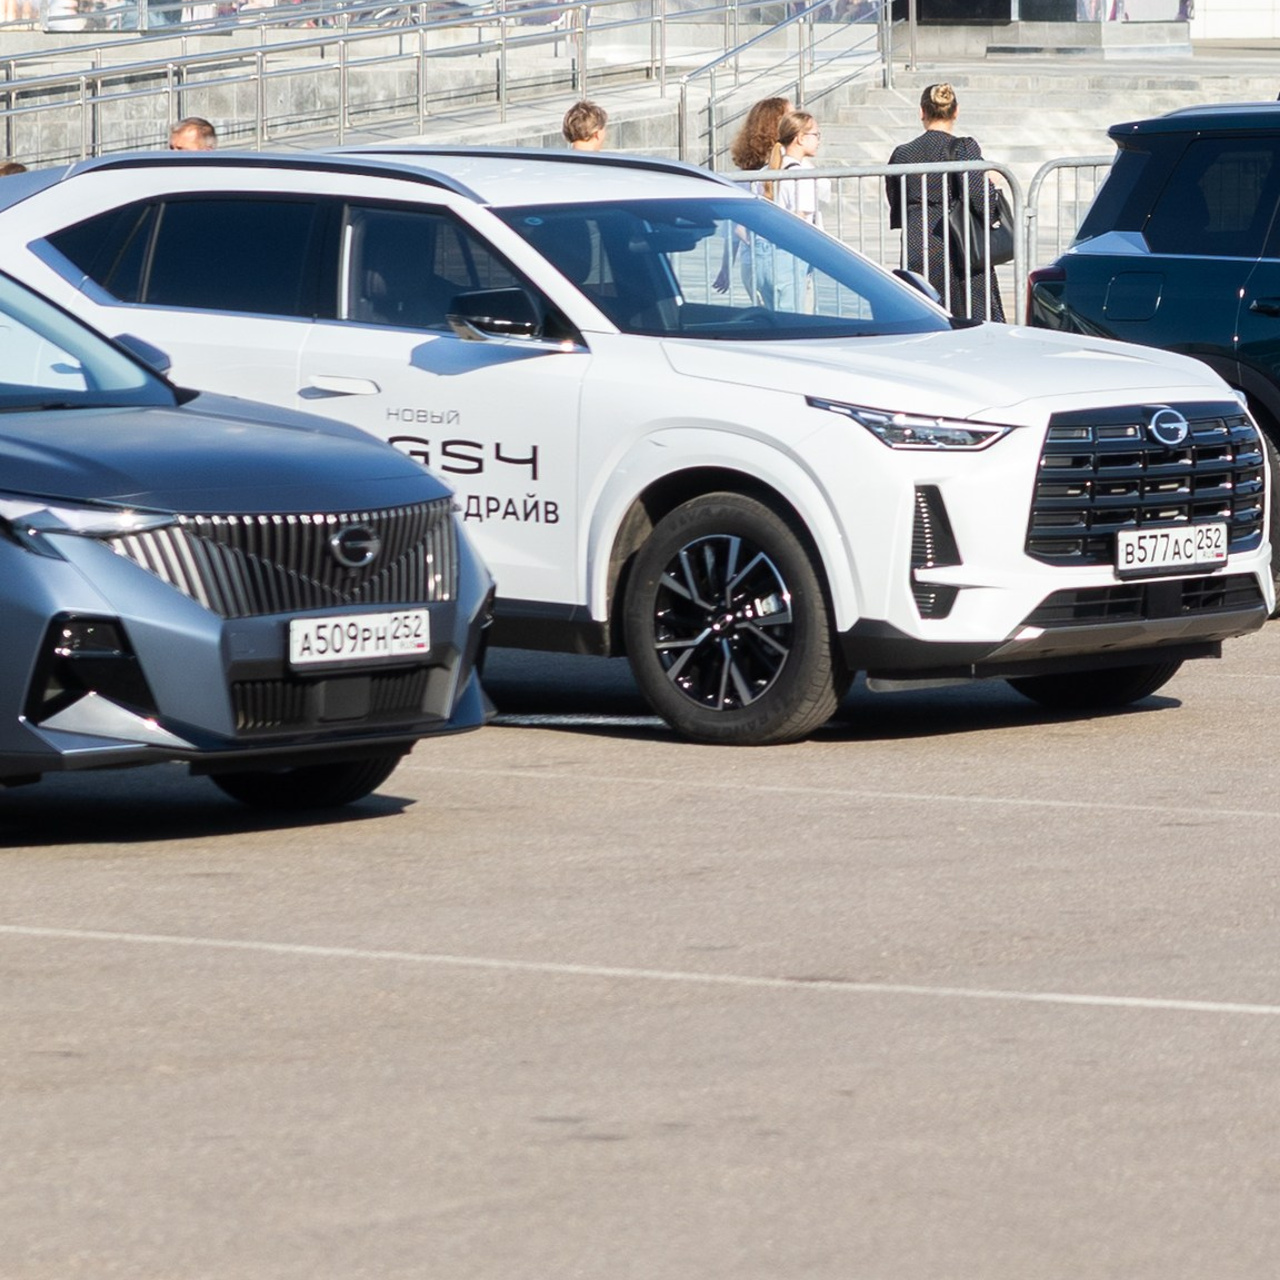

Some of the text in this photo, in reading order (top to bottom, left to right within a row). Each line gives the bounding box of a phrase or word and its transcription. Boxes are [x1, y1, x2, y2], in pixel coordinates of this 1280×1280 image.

[387, 435, 539, 480] GS4
[1125, 528, 1221, 564] В577АС 252
[300, 615, 422, 656] А509РН 252
